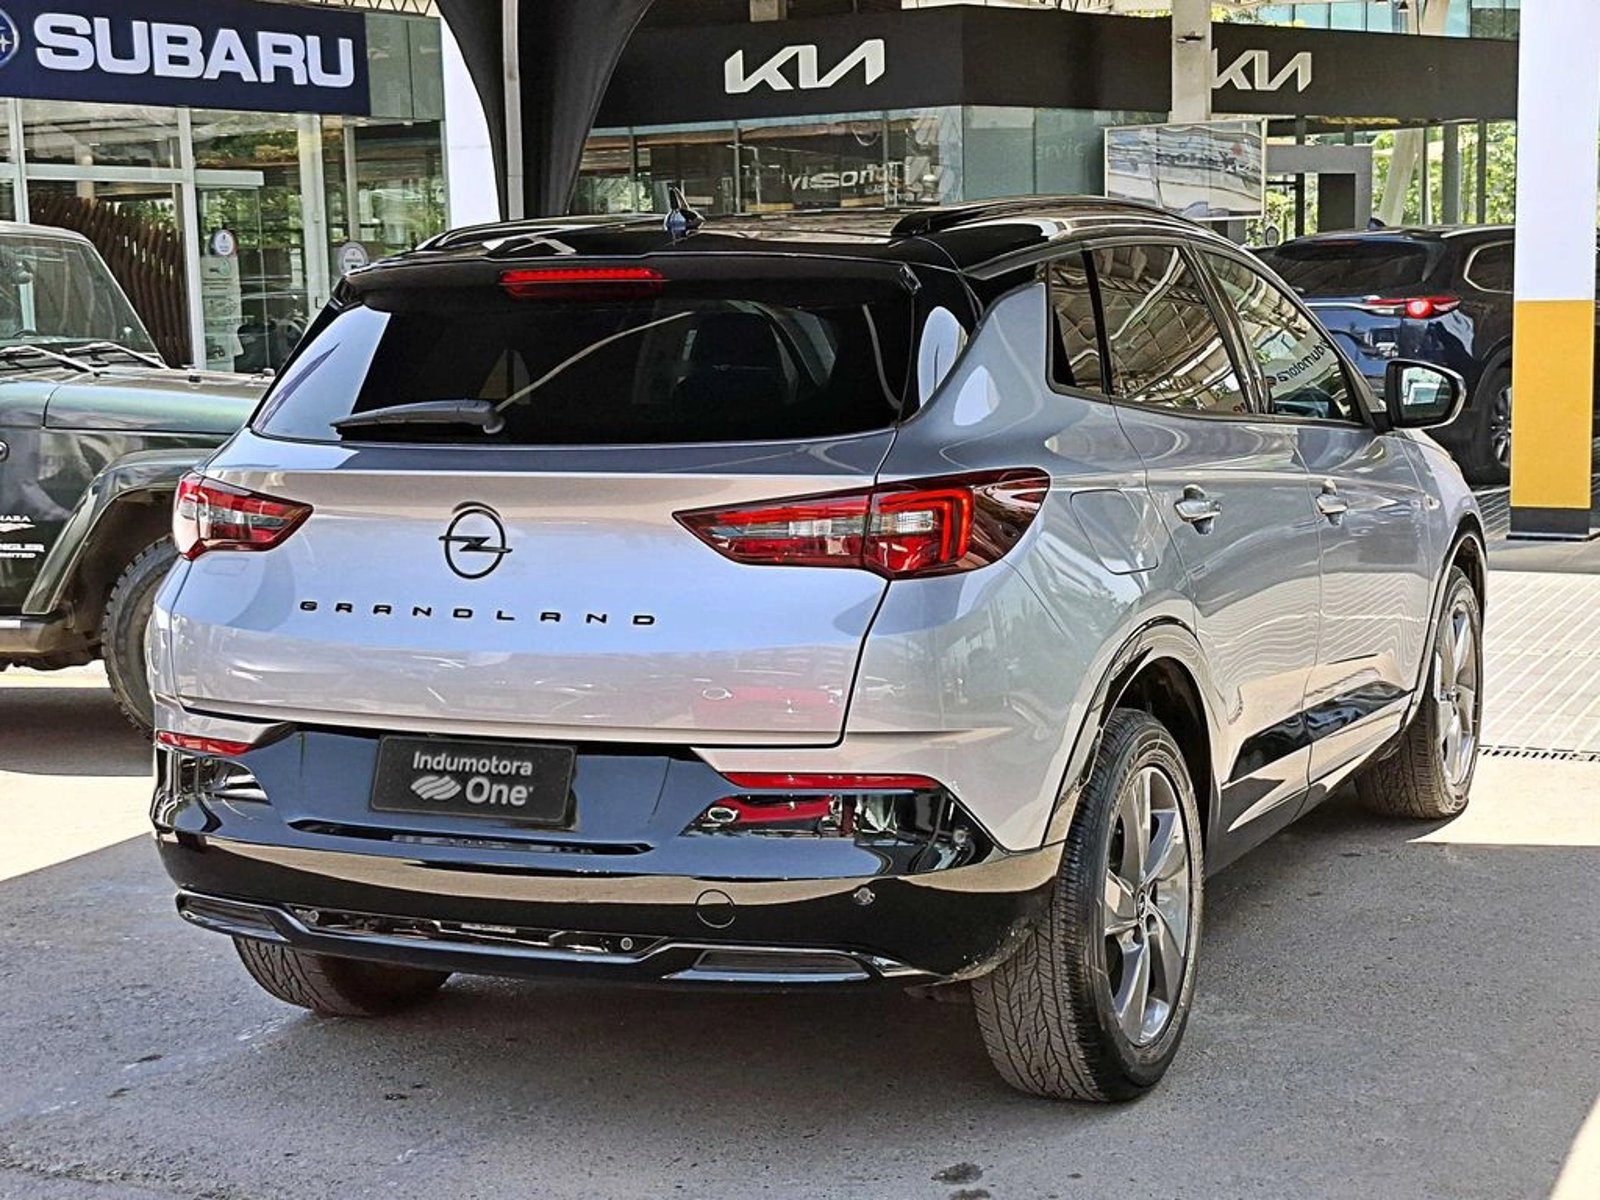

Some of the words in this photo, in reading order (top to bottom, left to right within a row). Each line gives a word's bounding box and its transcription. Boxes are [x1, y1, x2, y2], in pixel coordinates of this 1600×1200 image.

[34, 12, 354, 89] SUBARU
[724, 38, 886, 94] KIA
[1210, 48, 1312, 93] KIA
[299, 600, 655, 627] GRANDLAND
[413, 751, 533, 776] Indumotora
[465, 776, 529, 806] One
